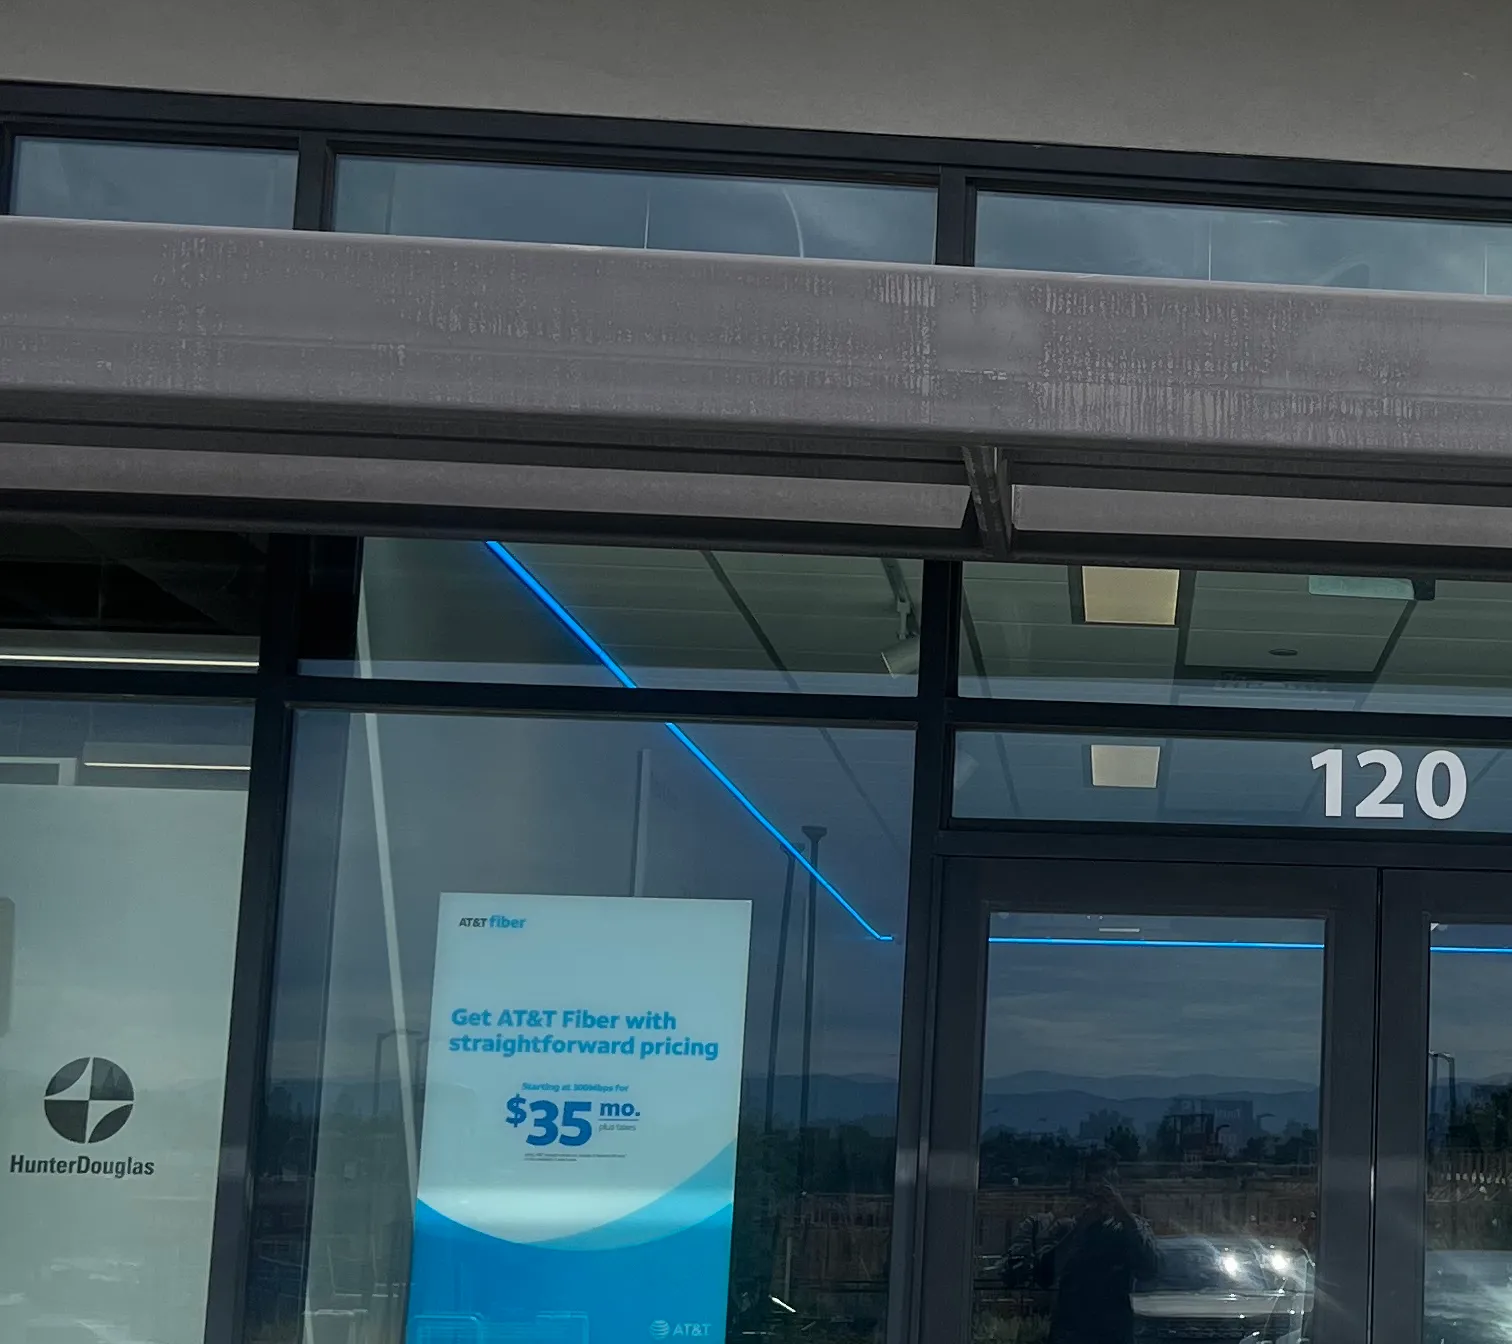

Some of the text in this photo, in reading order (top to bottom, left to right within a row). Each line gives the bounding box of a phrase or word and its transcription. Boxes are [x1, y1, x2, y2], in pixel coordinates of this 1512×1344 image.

[1310, 748, 1467, 820] 120
[459, 914, 527, 929] AT&T fiber
[451, 1008, 677, 1031] Get AT&T Fiber with
[448, 1033, 719, 1061] straightforward pricing
[505, 1093, 641, 1147] $35 mo.
[9, 1155, 155, 1179] HunterDouglas
[672, 1323, 711, 1337] AT&T
